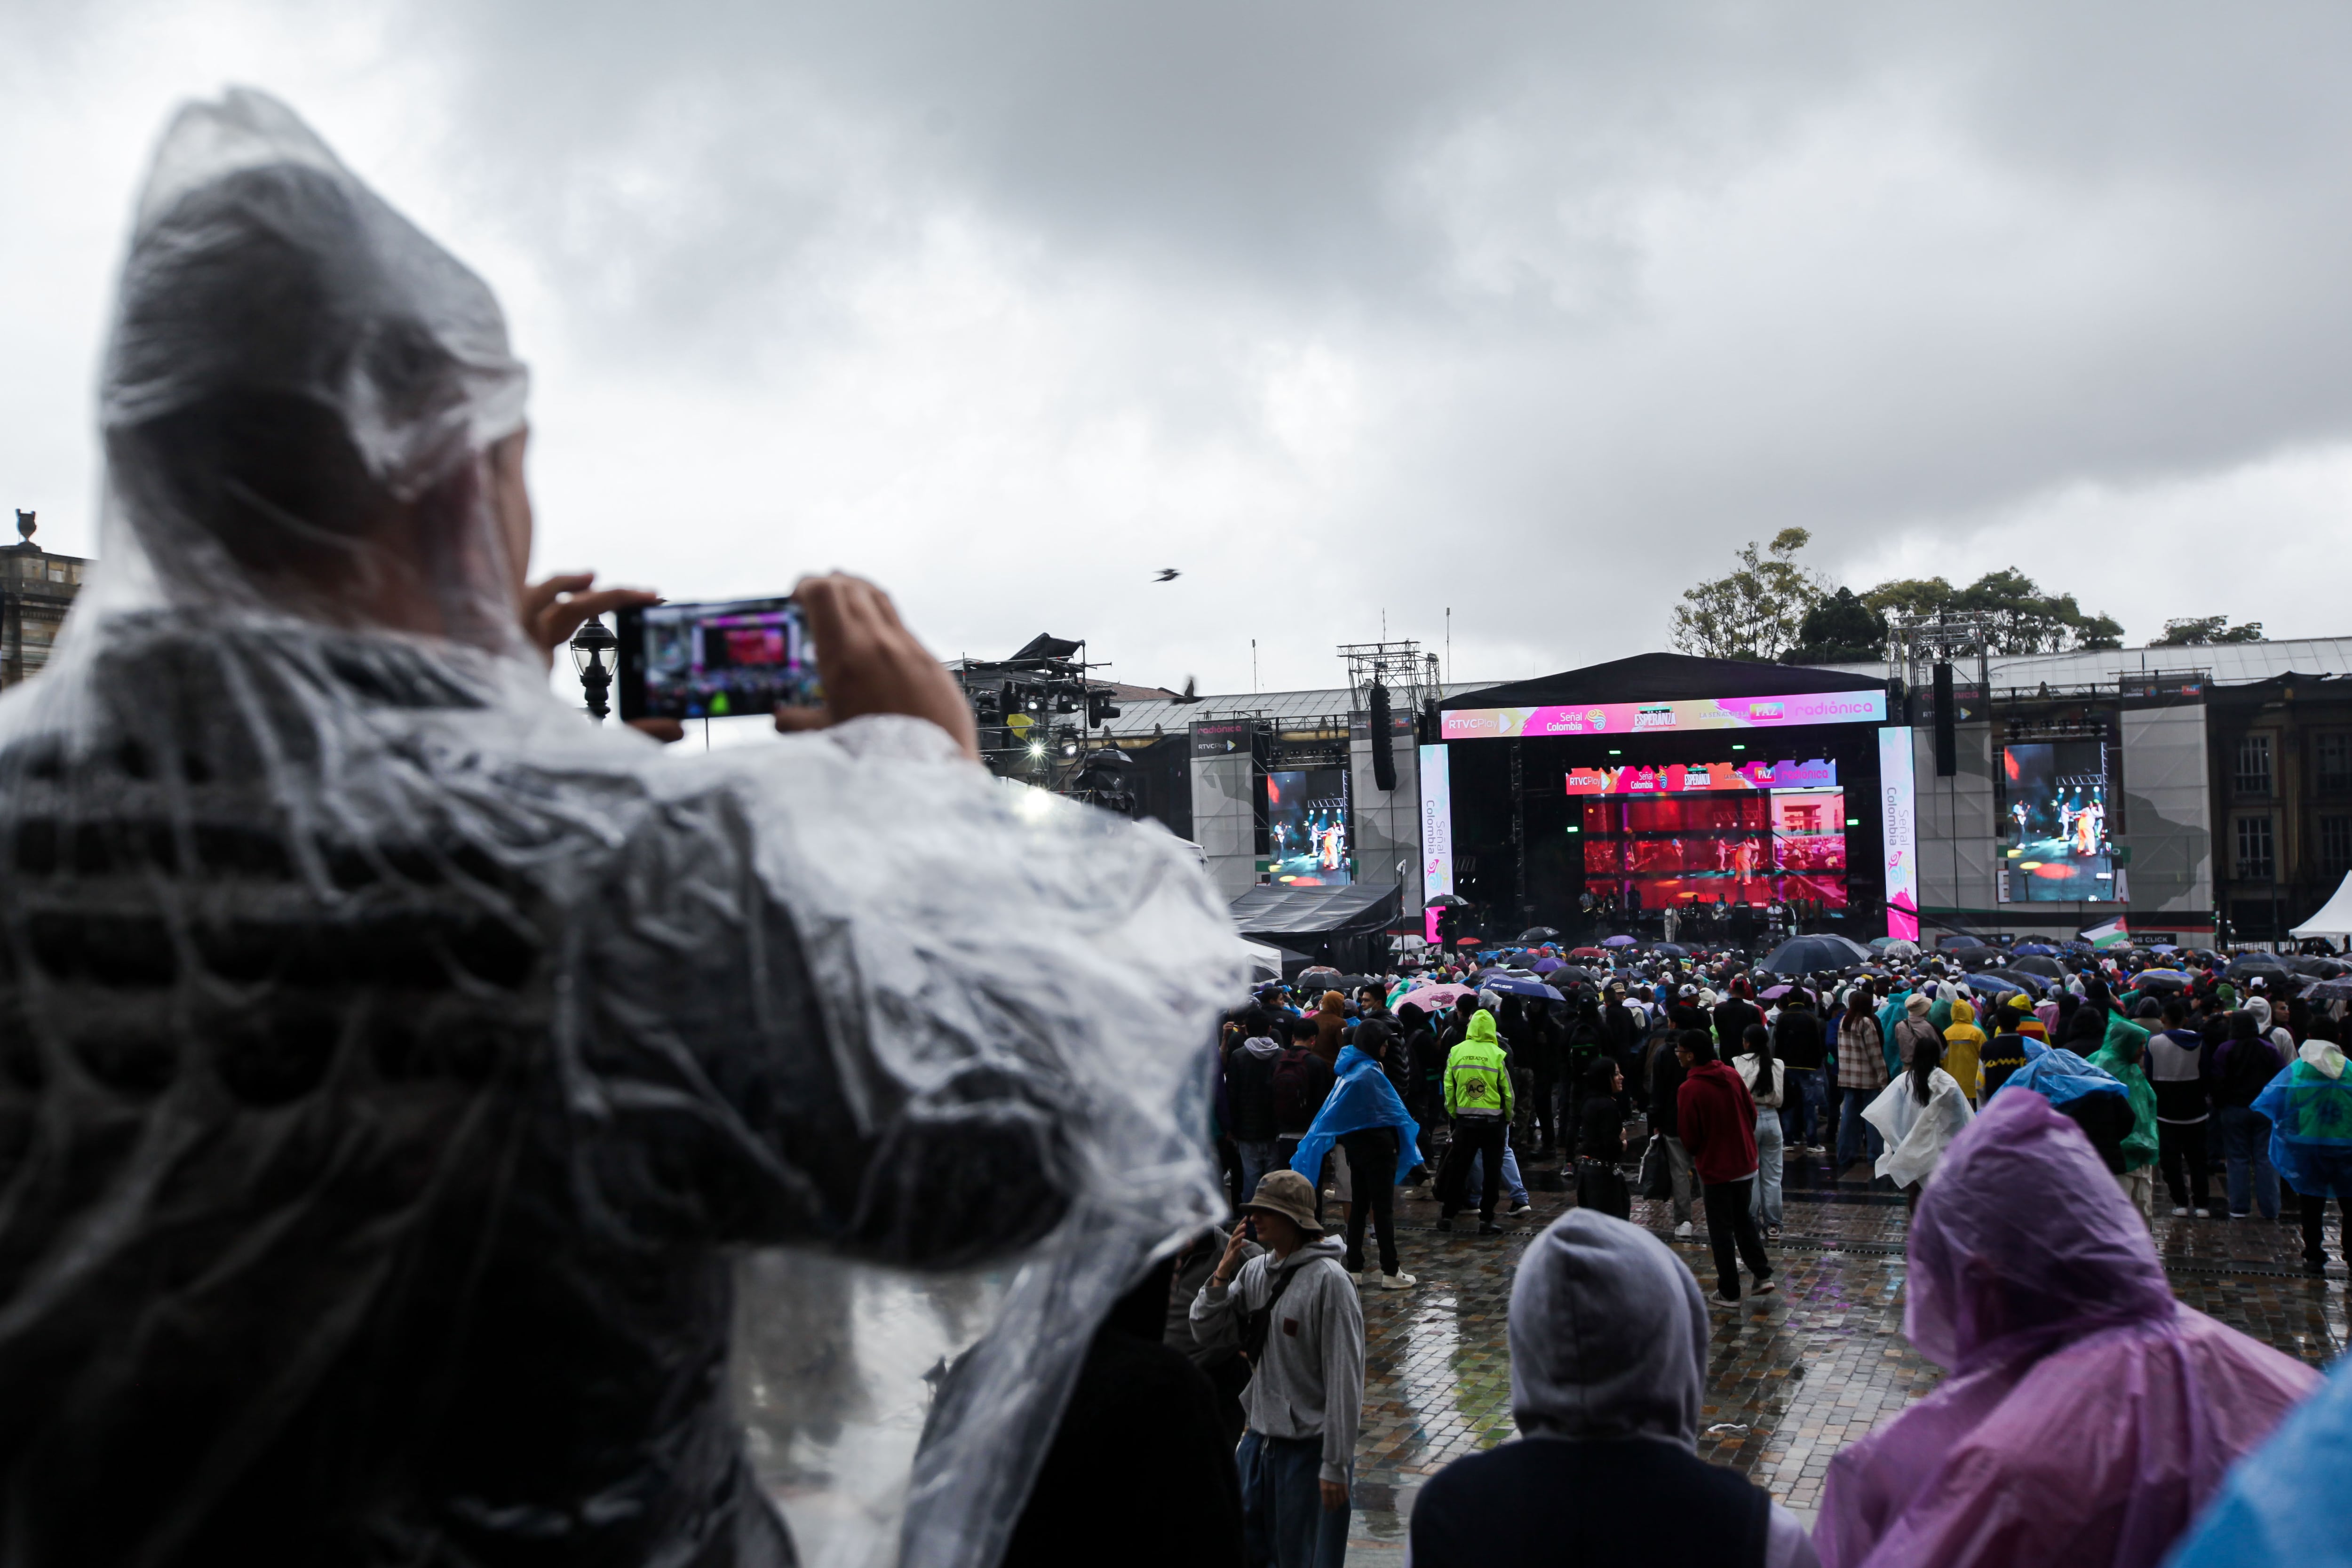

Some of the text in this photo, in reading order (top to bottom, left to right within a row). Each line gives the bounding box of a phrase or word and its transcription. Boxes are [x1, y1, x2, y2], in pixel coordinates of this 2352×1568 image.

[1560, 712, 1582, 722] Señal
[1756, 707, 1777, 716] PAZ
[1635, 713, 1676, 726] ESPERANZA
[1547, 722, 1582, 732] Colombia
[1638, 772, 1653, 780] Señal
[1685, 773, 1710, 785] ESPERANZA
[1758, 770, 1772, 779] PAZ
[1887, 787, 1897, 846] Colombia
[1899, 810, 1909, 845] Señal
[1436, 821, 1446, 854] Señal
